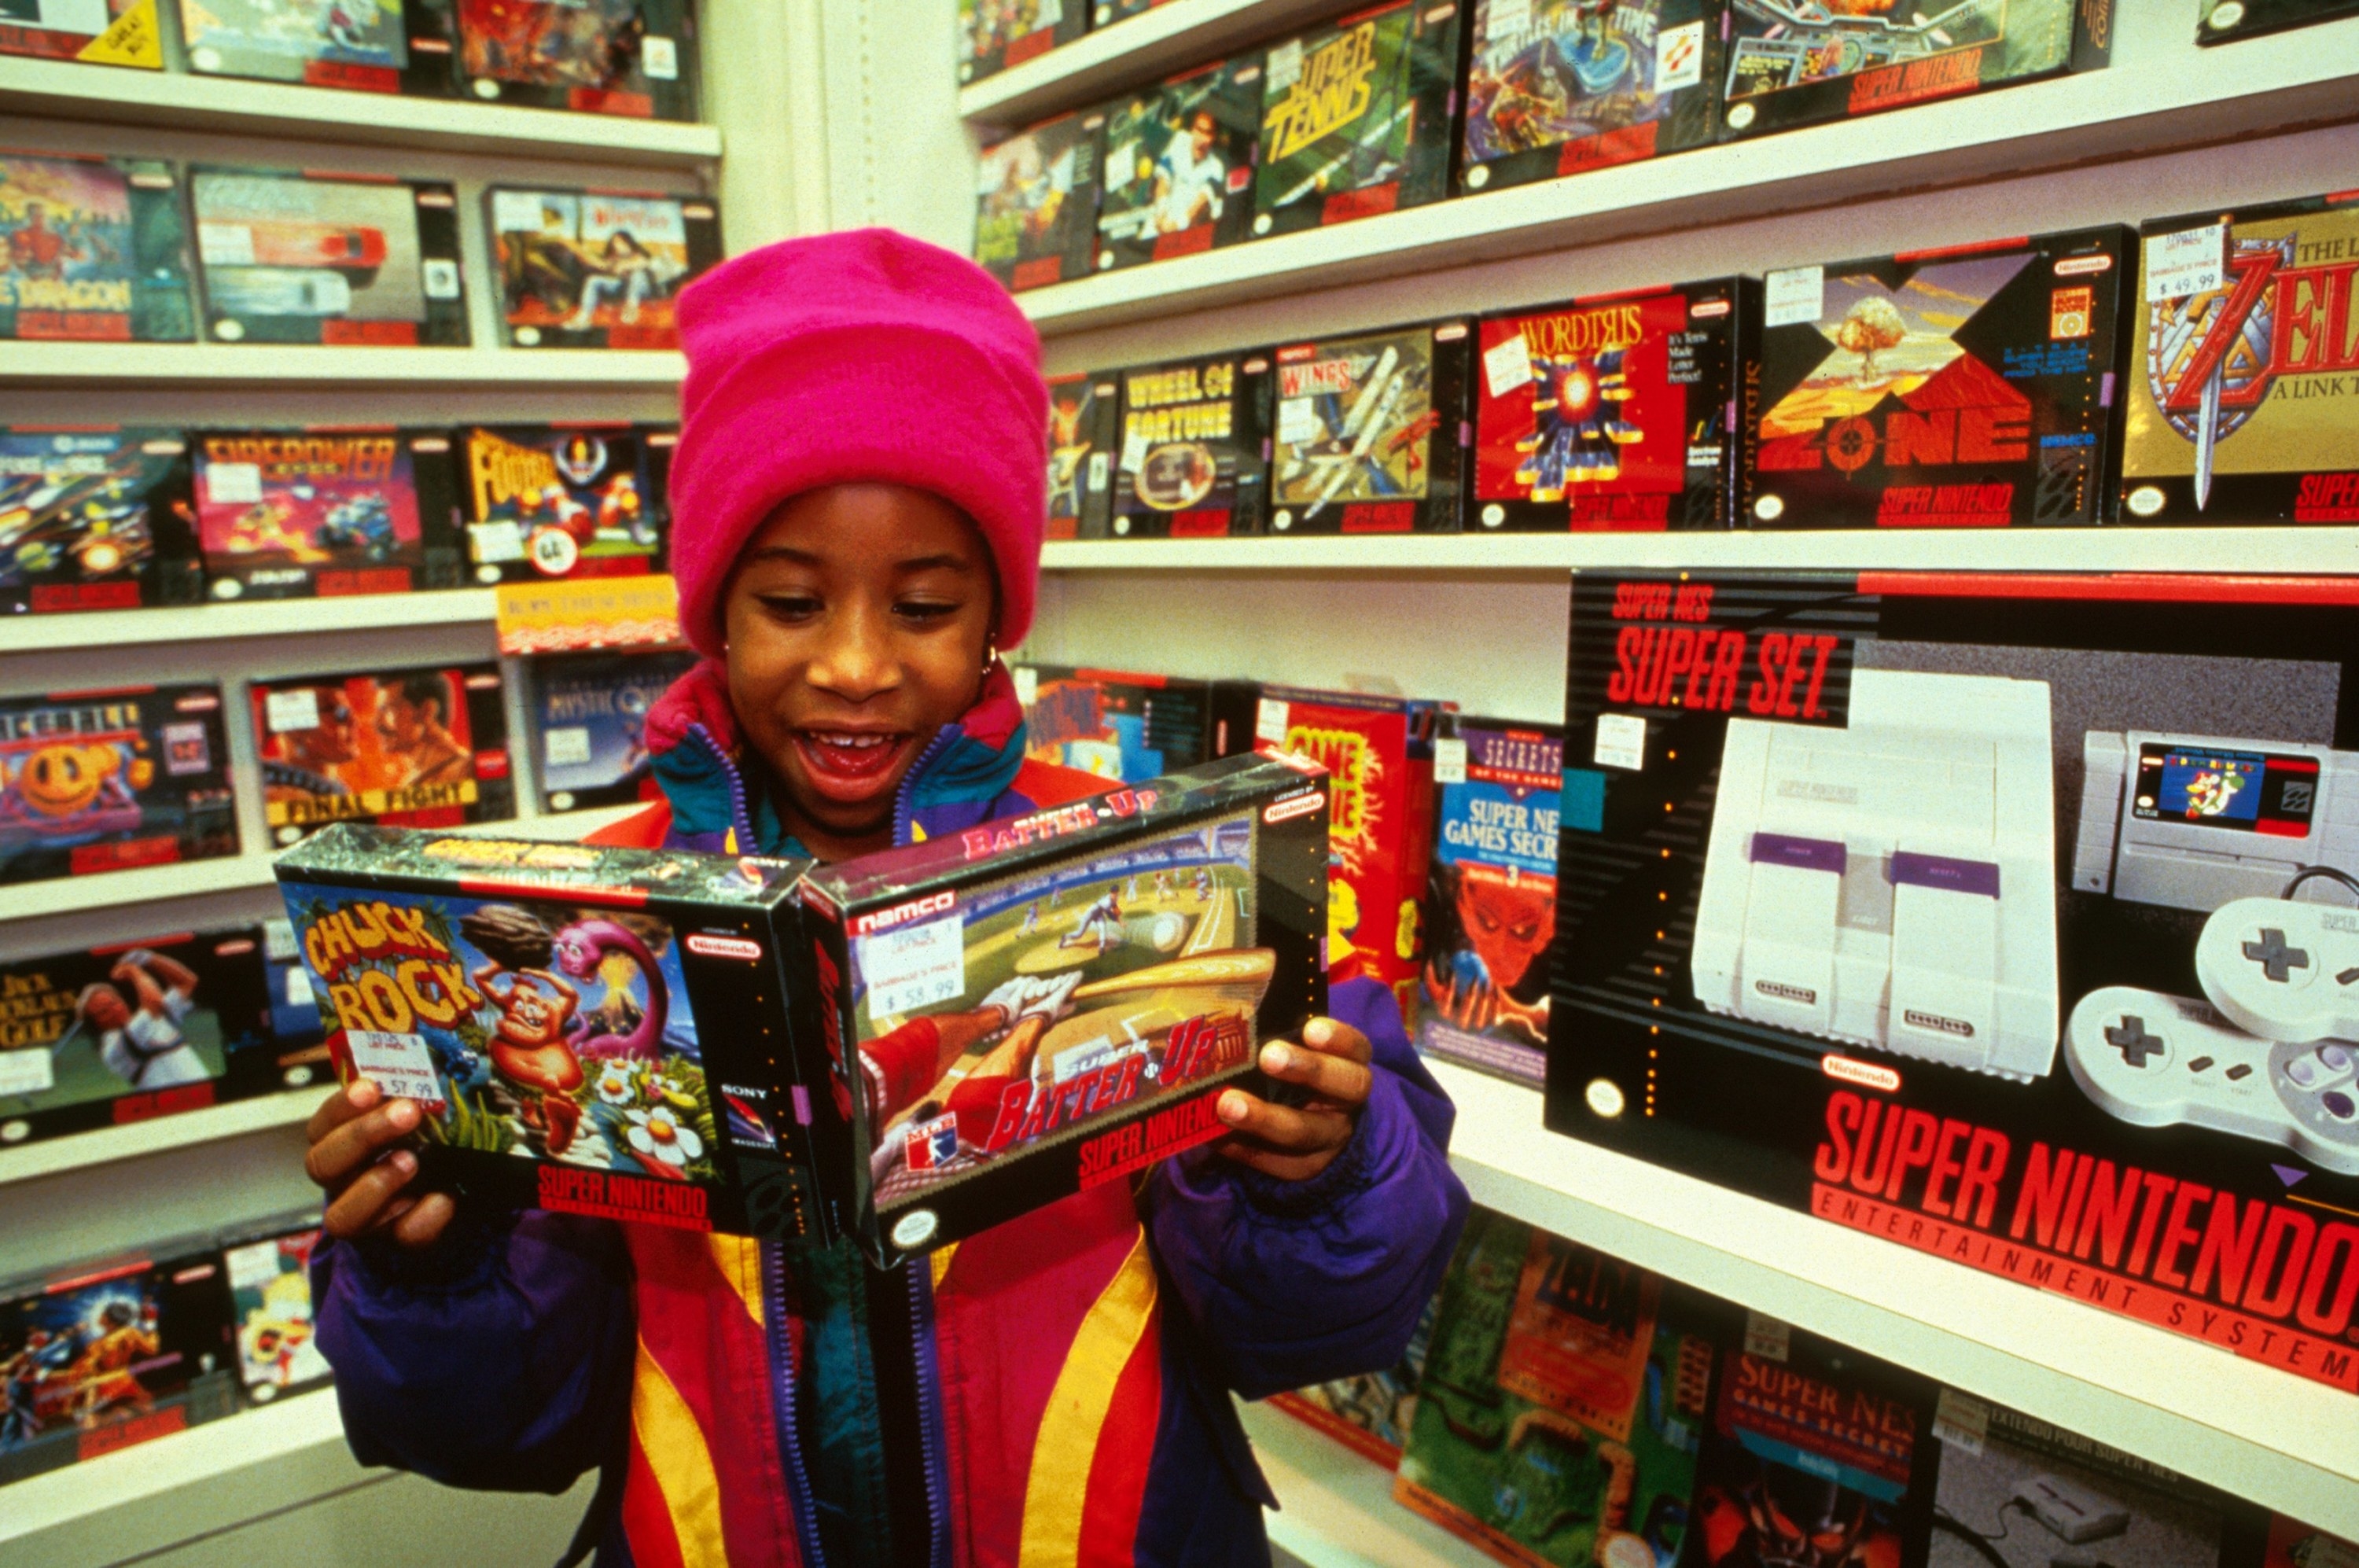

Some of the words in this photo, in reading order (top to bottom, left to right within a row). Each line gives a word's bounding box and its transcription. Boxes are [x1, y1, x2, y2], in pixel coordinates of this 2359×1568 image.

[1853, 65, 1903, 100] SUPER
[1902, 47, 1982, 90] NINTENDO
[1262, 58, 1377, 165] TENNIS
[2057, 259, 2108, 274] Nintendo
[2299, 238, 2345, 263] THE
[2160, 283, 2166, 295] $
[2166, 241, 2359, 409] ZEL
[1127, 367, 1203, 409] WHEEL
[1204, 362, 1234, 399] OF
[1280, 359, 1352, 398] WINGS
[2273, 382, 2288, 400] A
[2294, 377, 2346, 398] LINK
[2350, 375, 2359, 396] T
[1125, 400, 1232, 444] FORTUNE
[1756, 406, 2033, 475] ZONE
[1879, 485, 1934, 515] SUPER
[1933, 482, 2015, 515] NINTENDO
[2295, 474, 2359, 507] SUPE
[1613, 582, 1672, 620] SUPER
[1673, 584, 1714, 622] NES
[1608, 625, 1746, 712] SUPER
[1749, 632, 1838, 718] SET
[1485, 739, 1561, 774] SECRETS
[286, 793, 359, 823] FINAL
[384, 780, 460, 812] FIGHT
[1268, 797, 1322, 819] Nintendo
[1469, 797, 1528, 831] SUPER
[1533, 808, 1559, 835] NE
[962, 807, 1099, 861] BATTER
[1444, 819, 1507, 852] GAMES
[1509, 830, 1558, 862] SECR
[1507, 864, 1519, 887] 3
[858, 890, 955, 934] namco
[306, 901, 450, 977] CHUCK
[693, 939, 756, 955] Nintendo
[329, 958, 485, 1033] ROCK
[887, 995, 896, 1010] $
[1065, 1039, 1150, 1077] SUPER
[1827, 1060, 1895, 1087] Nintendo
[721, 1084, 767, 1100] SONY
[984, 1052, 1147, 1154] BATTER
[1157, 1014, 1222, 1088] UP
[907, 1117, 955, 1140] MLB
[1079, 1121, 1143, 1179] SUPER
[1145, 1084, 1233, 1152] NINTEND
[538, 1164, 605, 1204] SUPER
[608, 1176, 708, 1218] NINTENDO
[1813, 1090, 2011, 1229] SUPER
[2010, 1140, 2359, 1337] NINTENDO
[1819, 1194, 2138, 1311] ENTERTAINMENT
[2167, 1300, 2352, 1379] SYSTEM
[1733, 1387, 1808, 1424] GAMES
[1738, 1354, 1838, 1415] SUPER
[1852, 1389, 1916, 1444] NES
[2054, 1428, 2094, 1453] POUR
[2095, 1442, 2144, 1472] SUPER
